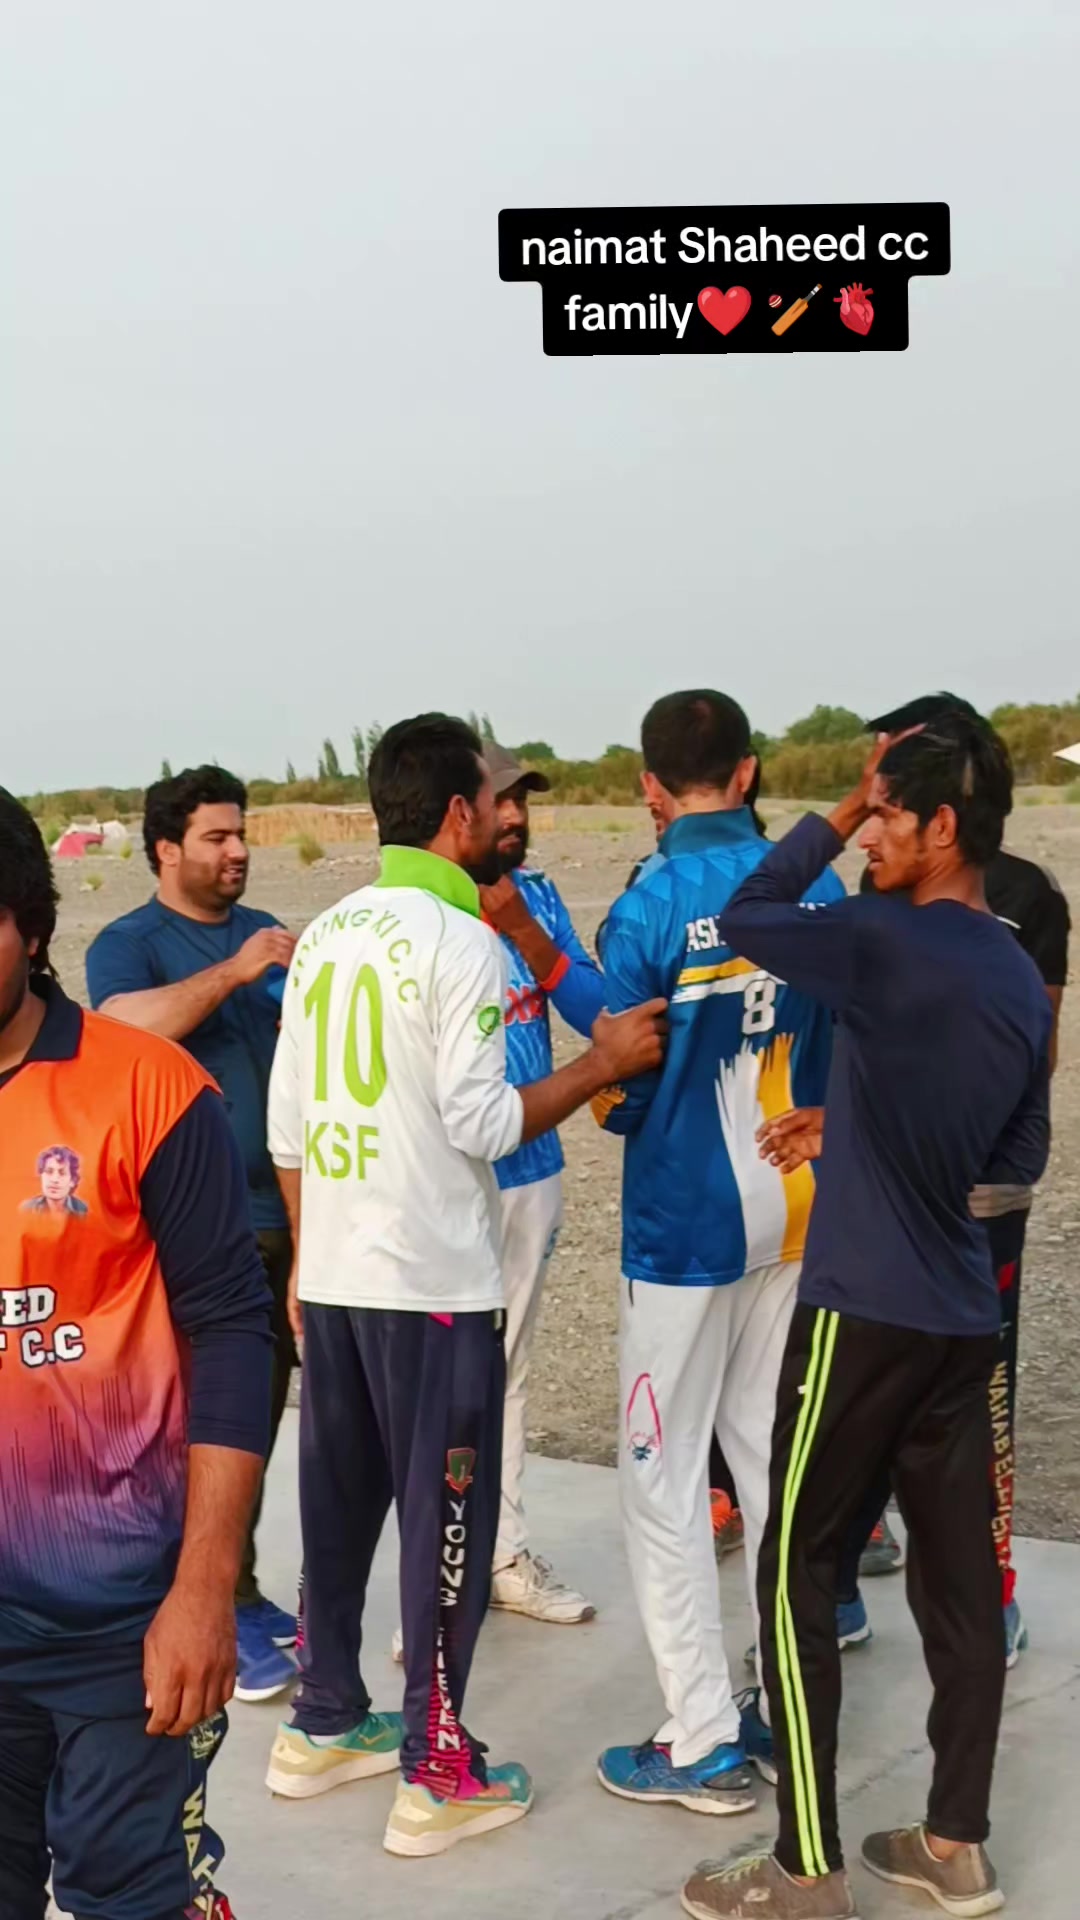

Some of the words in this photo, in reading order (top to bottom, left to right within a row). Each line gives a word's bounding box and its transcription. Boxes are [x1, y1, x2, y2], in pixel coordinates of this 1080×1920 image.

[685, 914, 729, 952] ASH
[304, 961, 387, 1107] 10
[741, 978, 777, 1035] 8
[304, 1119, 380, 1181] KSF
[0, 1286, 57, 1327] ED
[21, 1322, 86, 1368] C.C
[987, 1360, 1010, 1455] WAHAB
